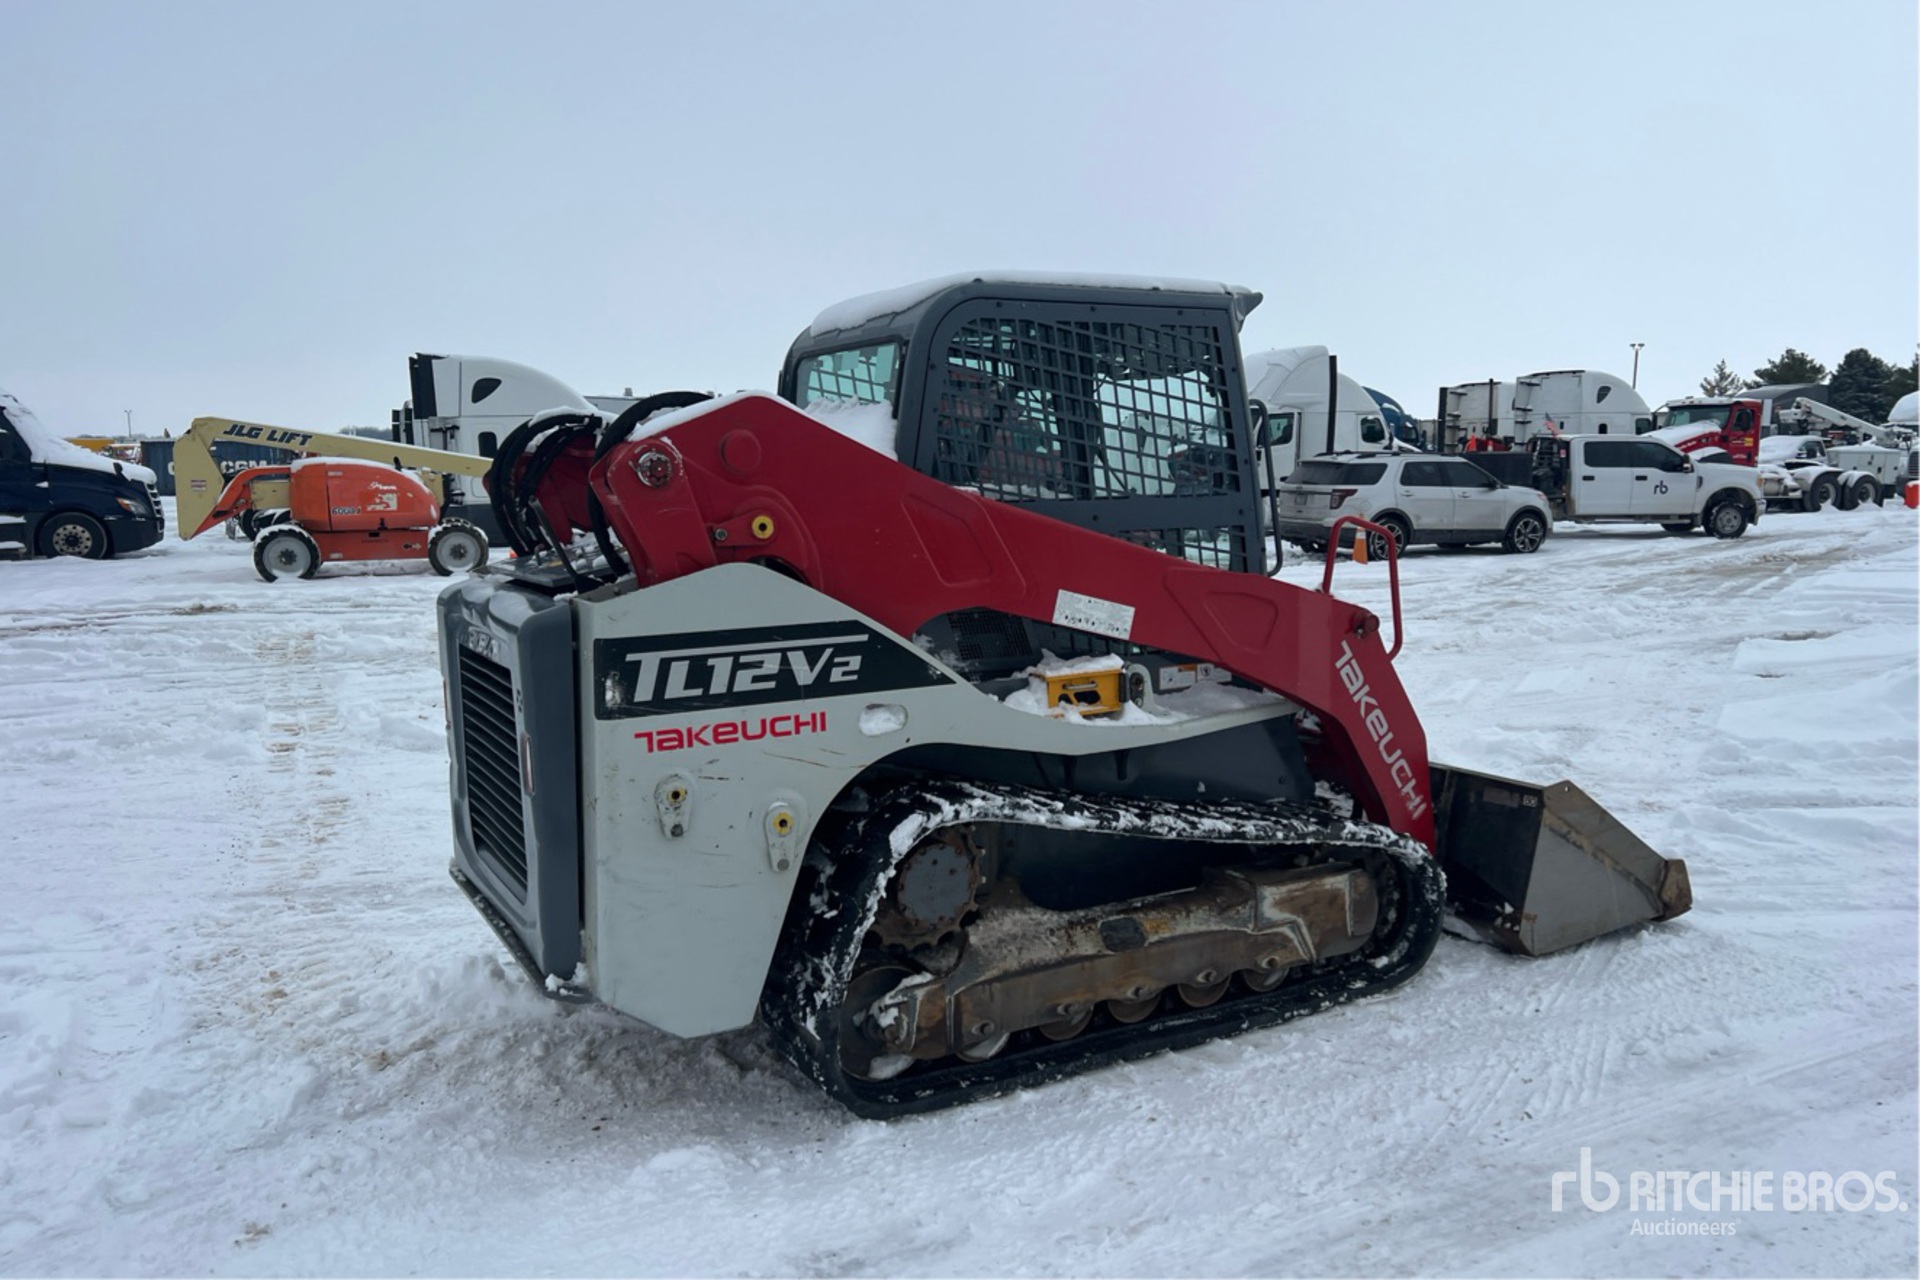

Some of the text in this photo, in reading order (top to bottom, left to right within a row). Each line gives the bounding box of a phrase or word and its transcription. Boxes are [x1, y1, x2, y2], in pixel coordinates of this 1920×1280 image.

[223, 424, 312, 446] JLG LIFT
[1653, 480, 1668, 494] rb
[634, 711, 827, 753] TAKEUCHI
[1335, 640, 1427, 820] TAKEUCHI
